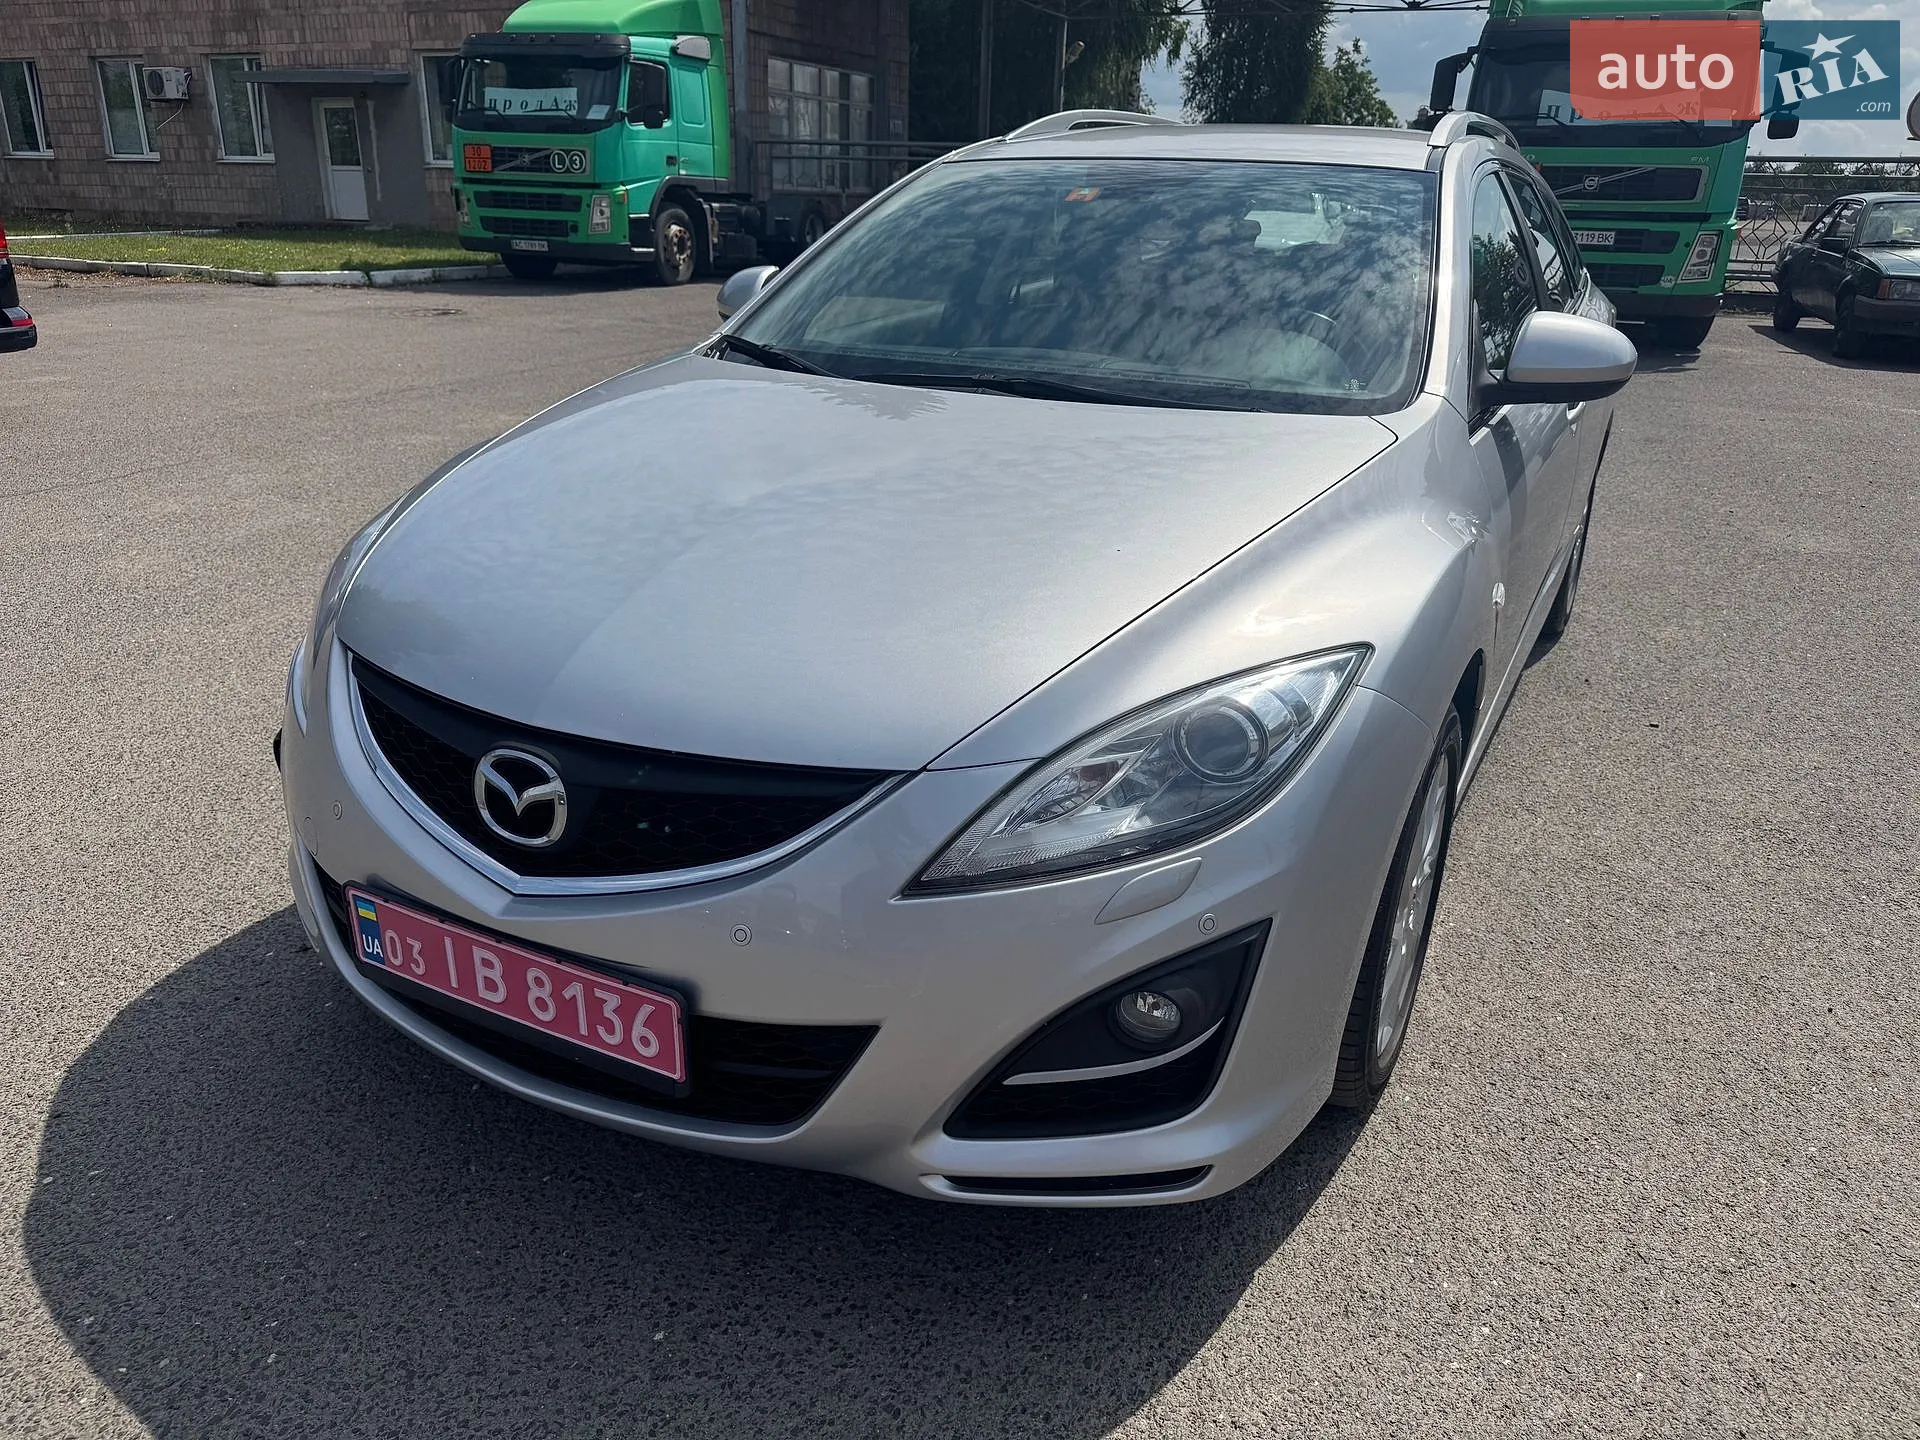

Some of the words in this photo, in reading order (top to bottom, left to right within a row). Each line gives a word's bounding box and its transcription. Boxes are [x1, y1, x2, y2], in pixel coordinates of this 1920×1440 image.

[470, 146, 482, 157] 30
[554, 154, 563, 169] L
[572, 155, 580, 169] 3
[362, 934, 384, 958] UA
[385, 929, 426, 976] 03
[526, 967, 660, 1058] 8136
